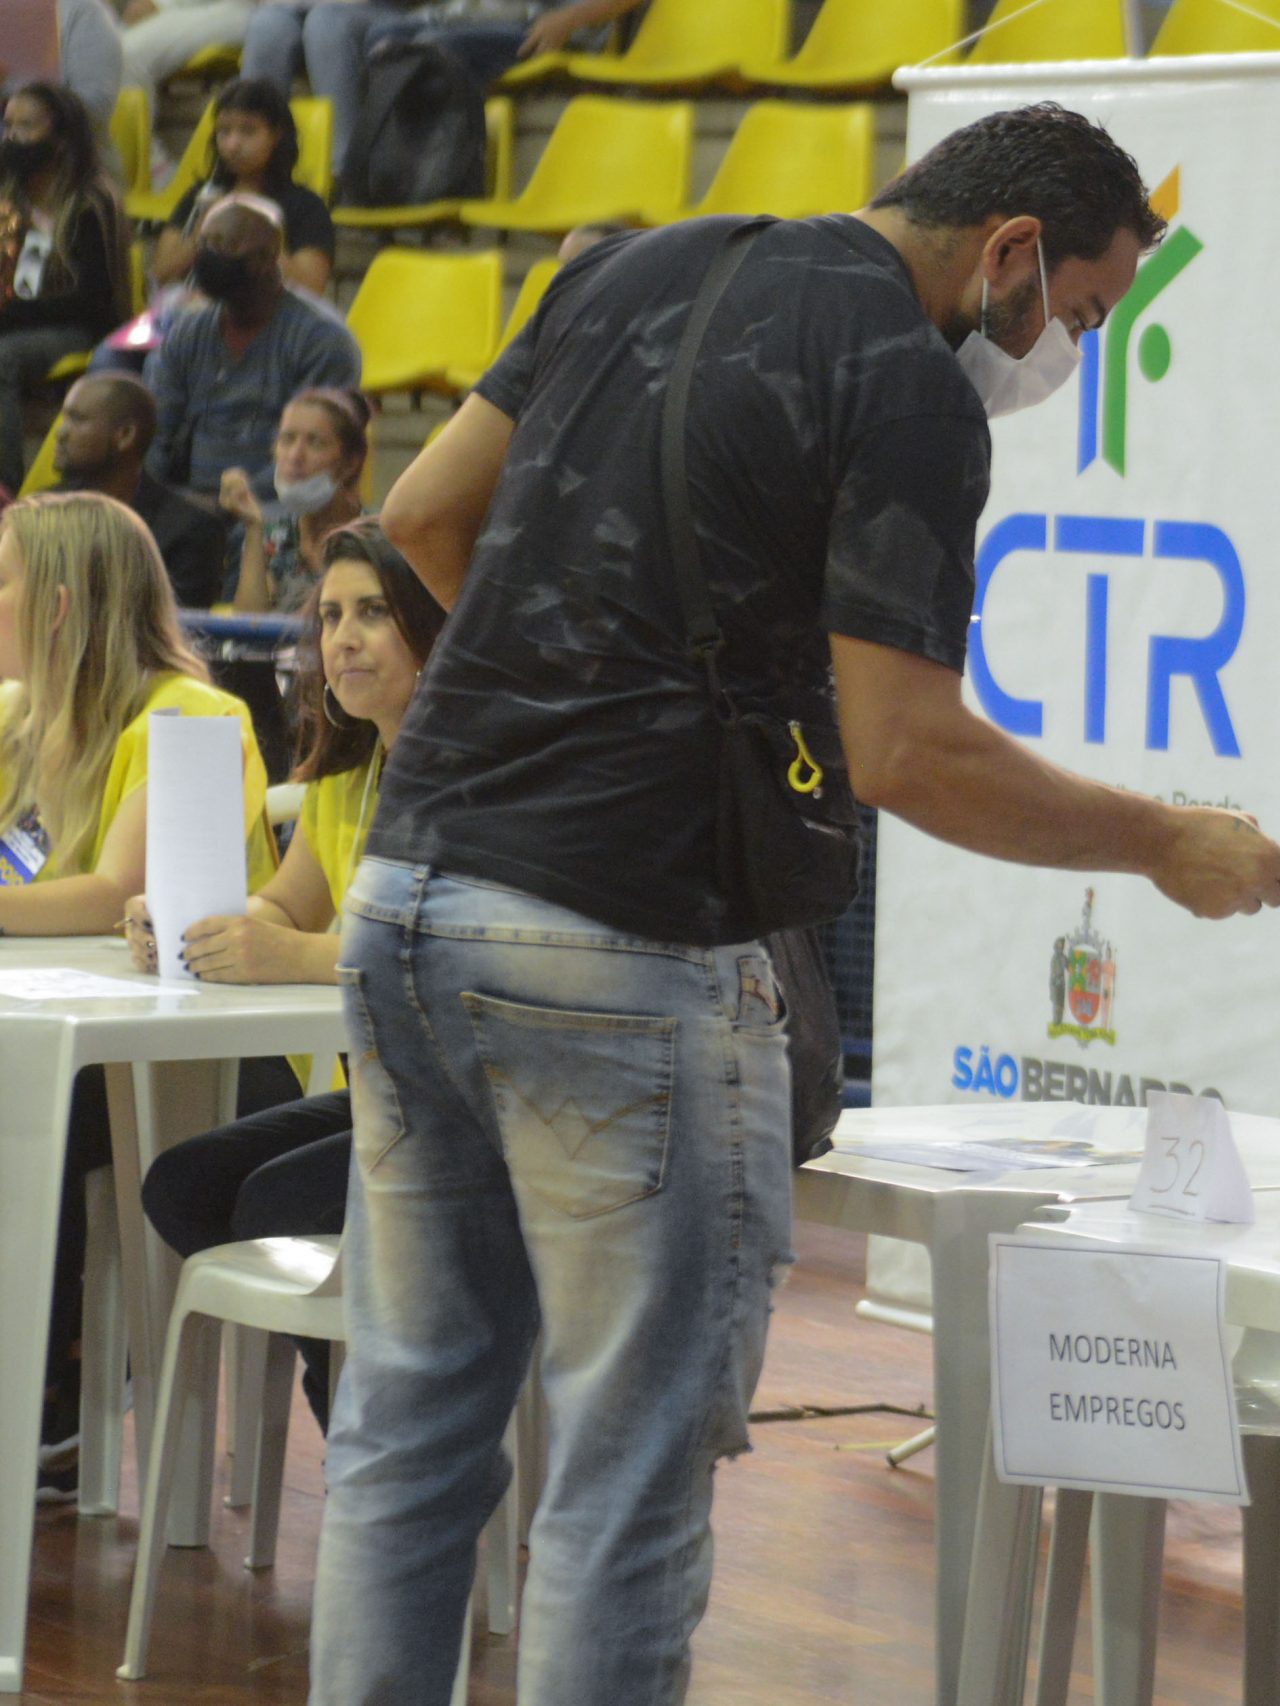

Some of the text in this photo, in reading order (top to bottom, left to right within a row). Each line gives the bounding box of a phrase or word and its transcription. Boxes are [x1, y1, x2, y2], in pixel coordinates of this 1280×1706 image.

[967, 512, 1246, 759] CTR
[951, 1045, 1224, 1107] SÃO BERNA
[1149, 1136, 1206, 1198] 32
[1049, 1333, 1177, 1371] MODERNA
[1050, 1392, 1186, 1431] EMPREGOS
